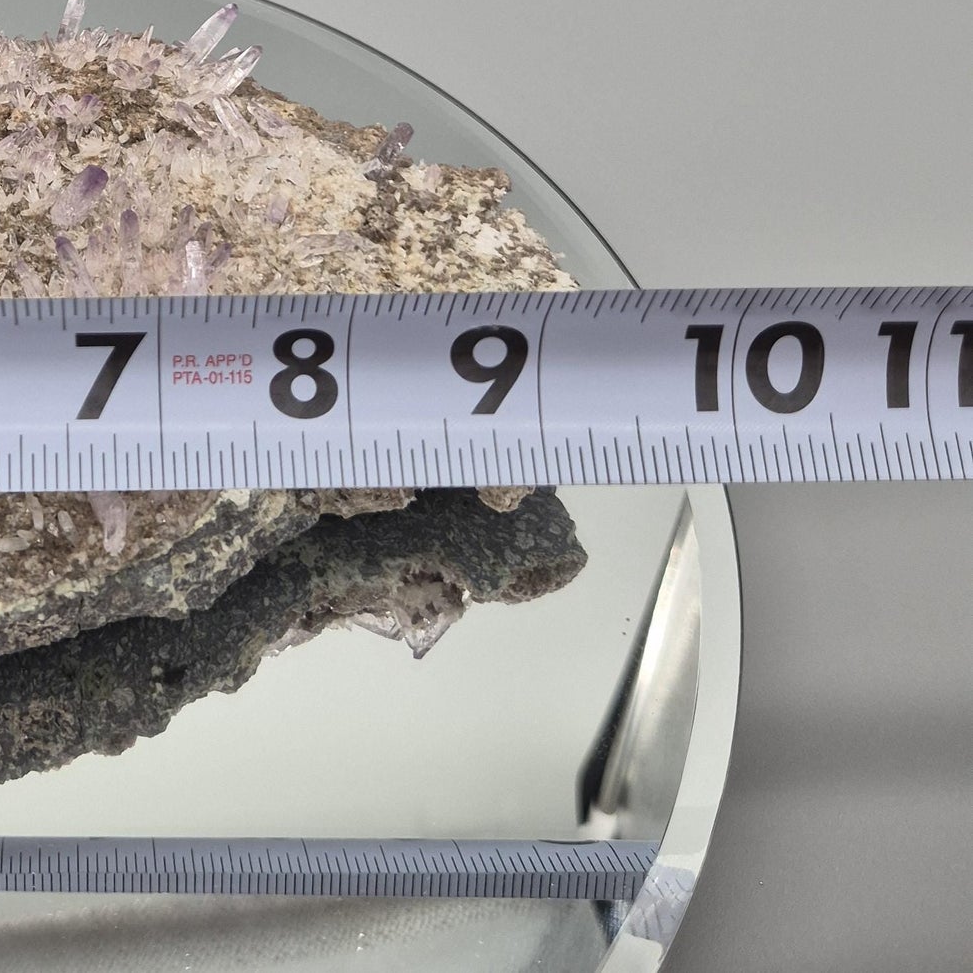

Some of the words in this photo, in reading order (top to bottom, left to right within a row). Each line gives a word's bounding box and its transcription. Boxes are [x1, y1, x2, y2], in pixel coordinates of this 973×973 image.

[75, 332, 147, 419] 7
[173, 355, 200, 367] P.R.
[205, 354, 253, 367] APP'D
[173, 370, 253, 384] PTA-01-115
[269, 328, 338, 419] 8
[448, 325, 528, 415] 9
[686, 321, 825, 414] 10
